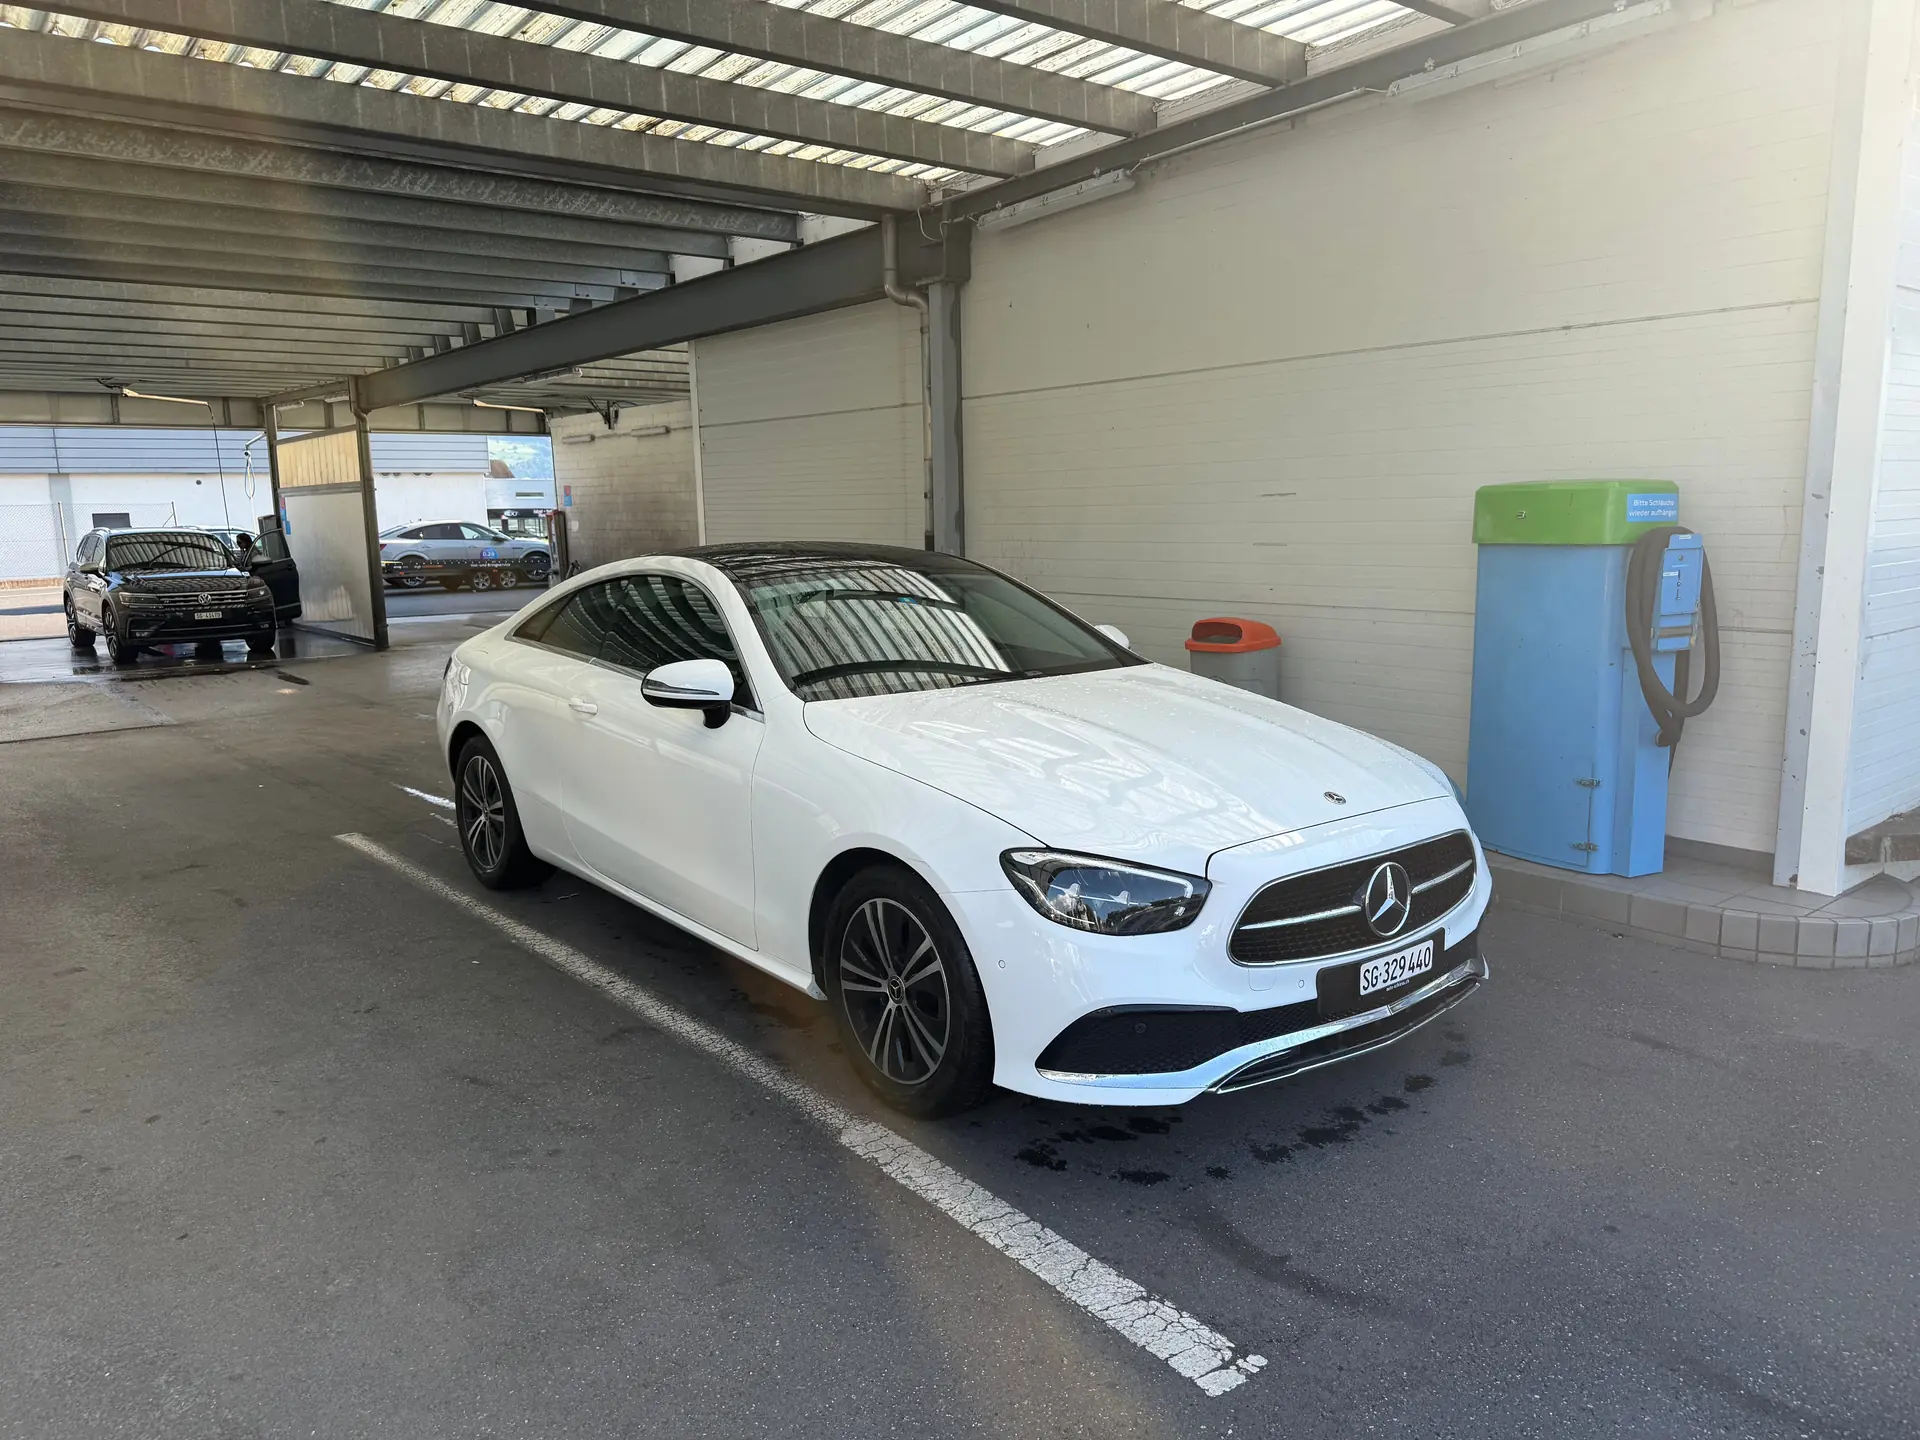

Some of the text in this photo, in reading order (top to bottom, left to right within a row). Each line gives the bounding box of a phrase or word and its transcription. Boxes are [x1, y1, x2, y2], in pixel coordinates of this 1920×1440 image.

[1633, 499, 1648, 507] Bitte
[1628, 509, 1650, 517] wieder
[1408, 946, 1431, 976] 440
